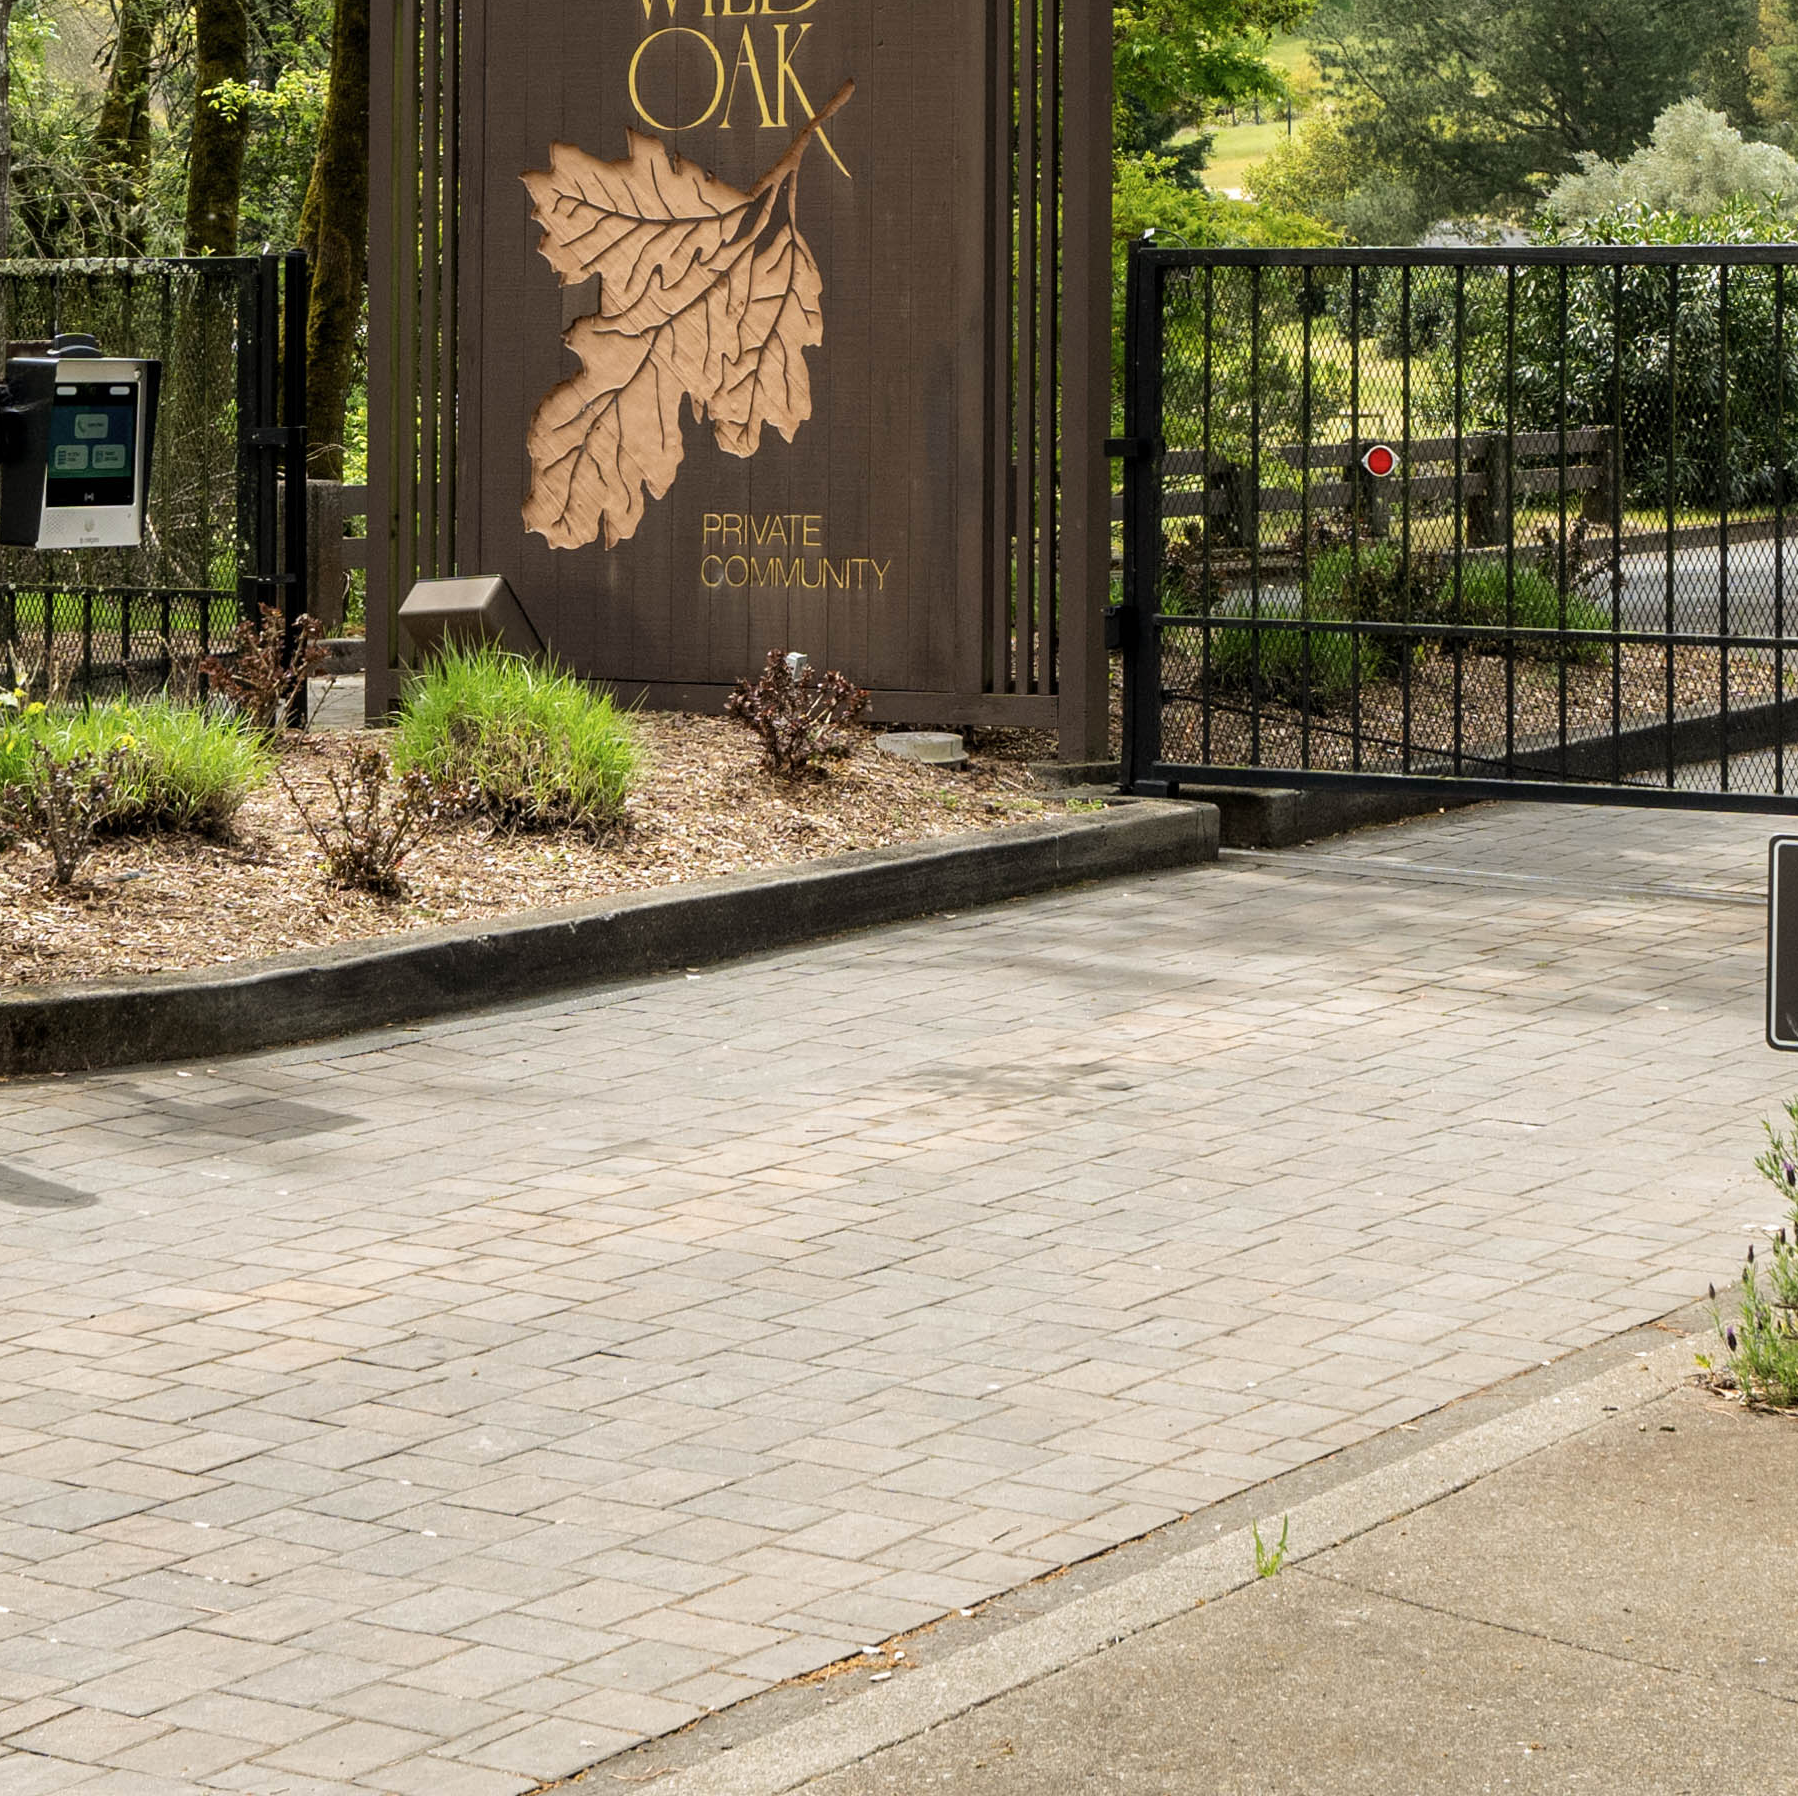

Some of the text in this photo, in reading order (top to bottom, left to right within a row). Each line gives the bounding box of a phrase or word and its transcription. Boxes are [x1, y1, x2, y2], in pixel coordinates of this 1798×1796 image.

[628, 22, 852, 180] OAK
[703, 513, 823, 547] PRIVATE
[700, 554, 892, 591] COMMUNITY
